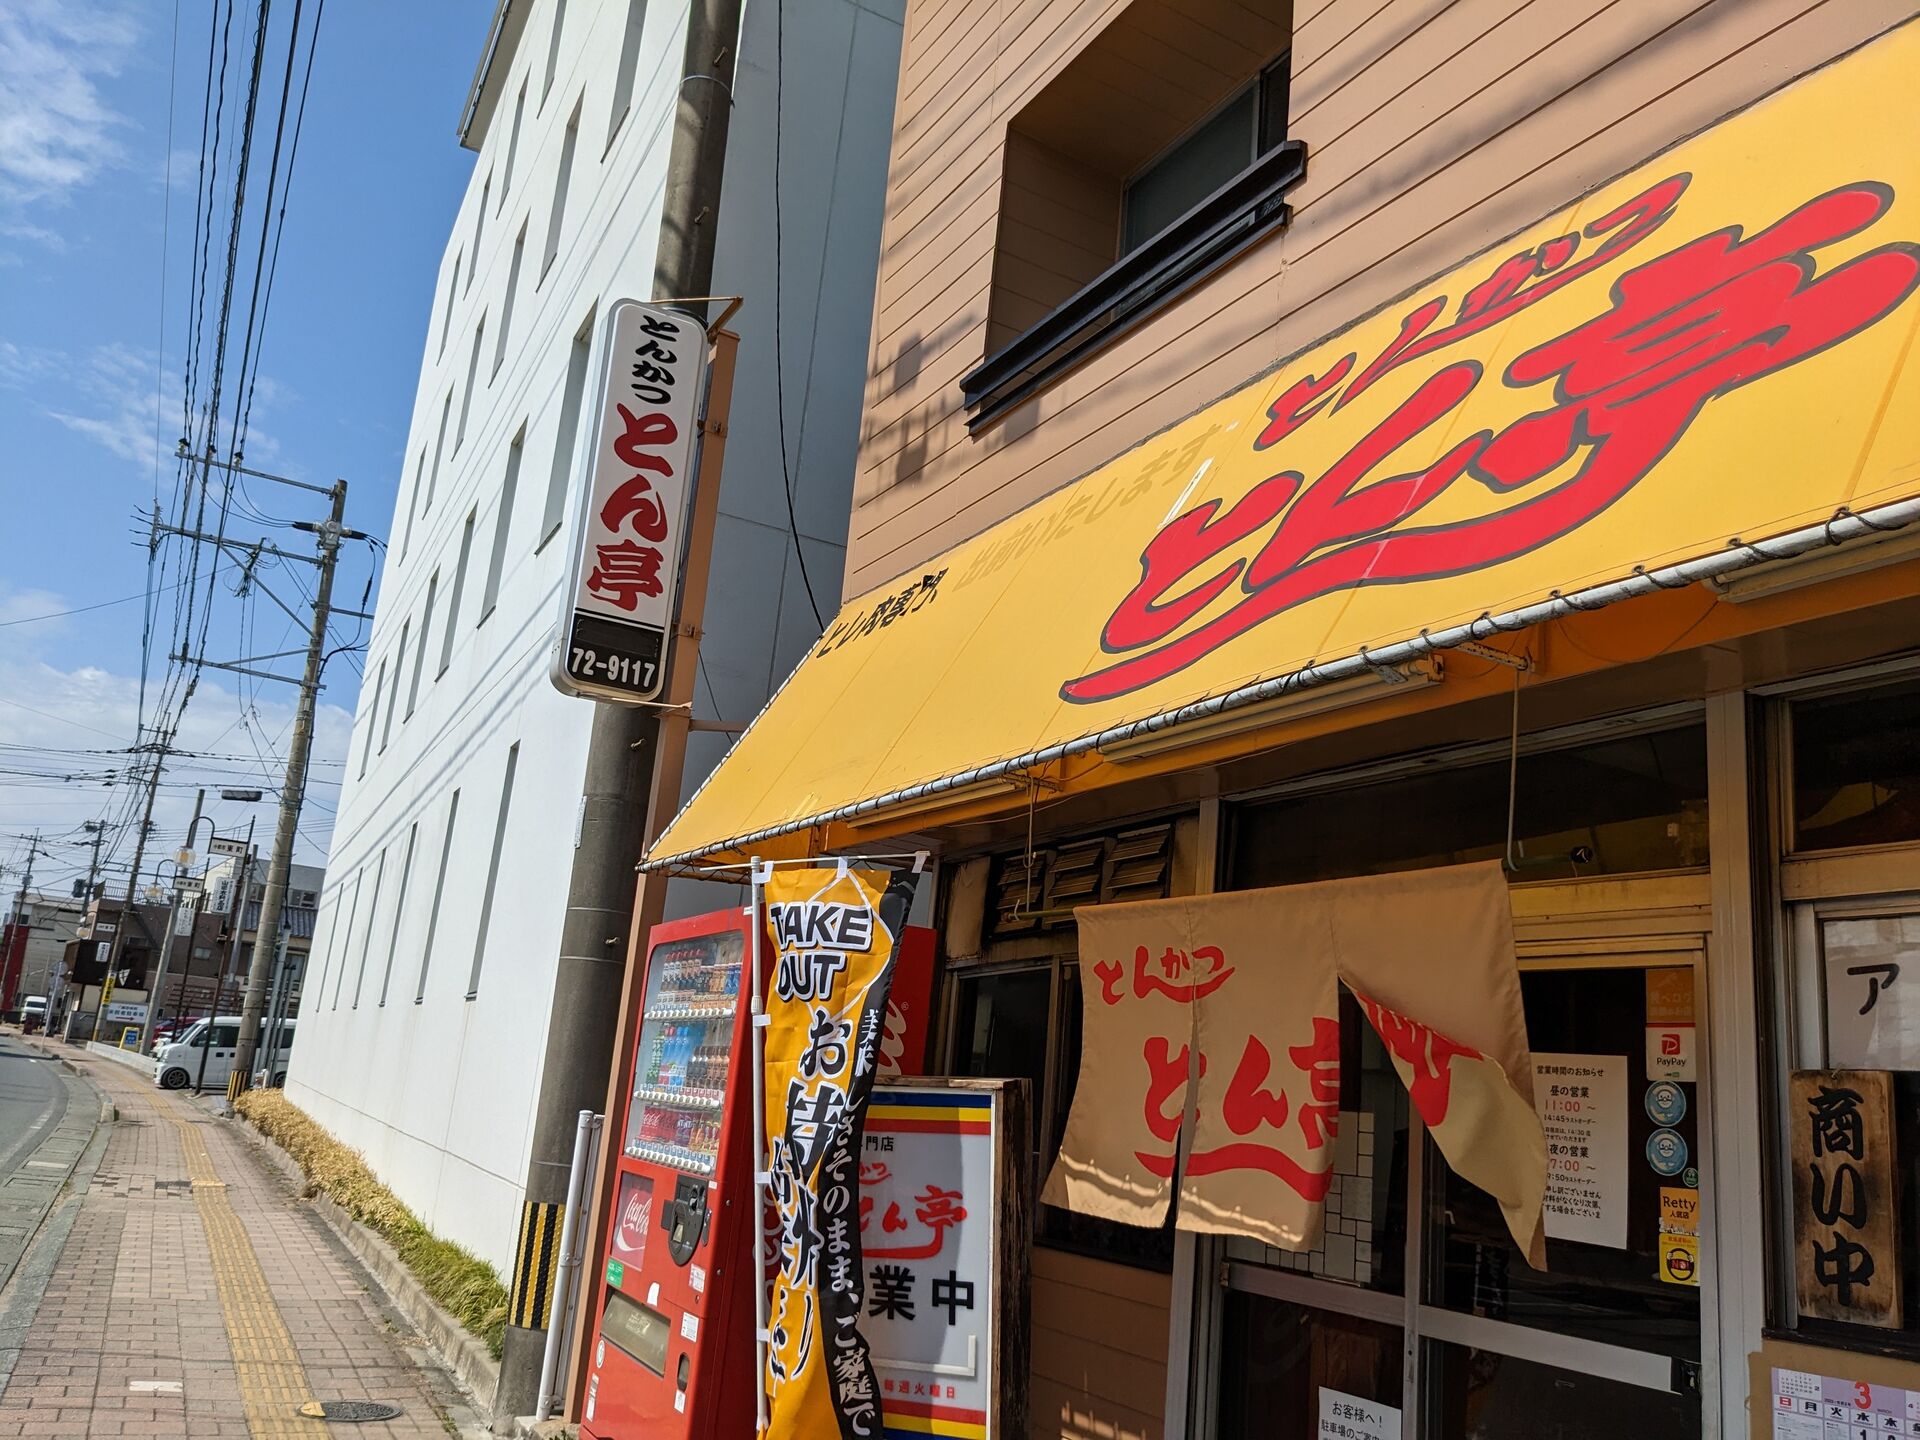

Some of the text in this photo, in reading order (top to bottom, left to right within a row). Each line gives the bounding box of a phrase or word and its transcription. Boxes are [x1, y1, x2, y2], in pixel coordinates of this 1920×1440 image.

[1253, 172, 1692, 451] とんかつ
[632, 314, 681, 405] とんかつ
[1059, 181, 1920, 704] とん亭
[586, 403, 679, 612] とん亭
[572, 647, 655, 687] 72-9117
[769, 903, 874, 950] TAKE
[777, 953, 842, 1002] OUT
[1093, 945, 1236, 1006] とんかつ
[1847, 963, 1900, 1015] ア
[1536, 1065, 1605, 1077] 営業時間のお知らせ
[1656, 1057, 1687, 1067] PayPay
[1549, 1085, 1590, 1098] 昼の営業
[1545, 1099, 1580, 1113] 11:00
[860, 1135, 895, 1152] 門店
[1549, 1144, 1590, 1158] 夜の営業
[1662, 1195, 1697, 1212] Retty
[1808, 1085, 1875, 1307] 商い中
[884, 1379, 956, 1399] 毎週火曜日
[1779, 1396, 1792, 1407] 日
[1854, 1380, 1872, 1410] 3
[1332, 1400, 1382, 1428] お客様へ！
[1804, 1401, 1817, 1412] 月
[1831, 1406, 1842, 1417] 火
